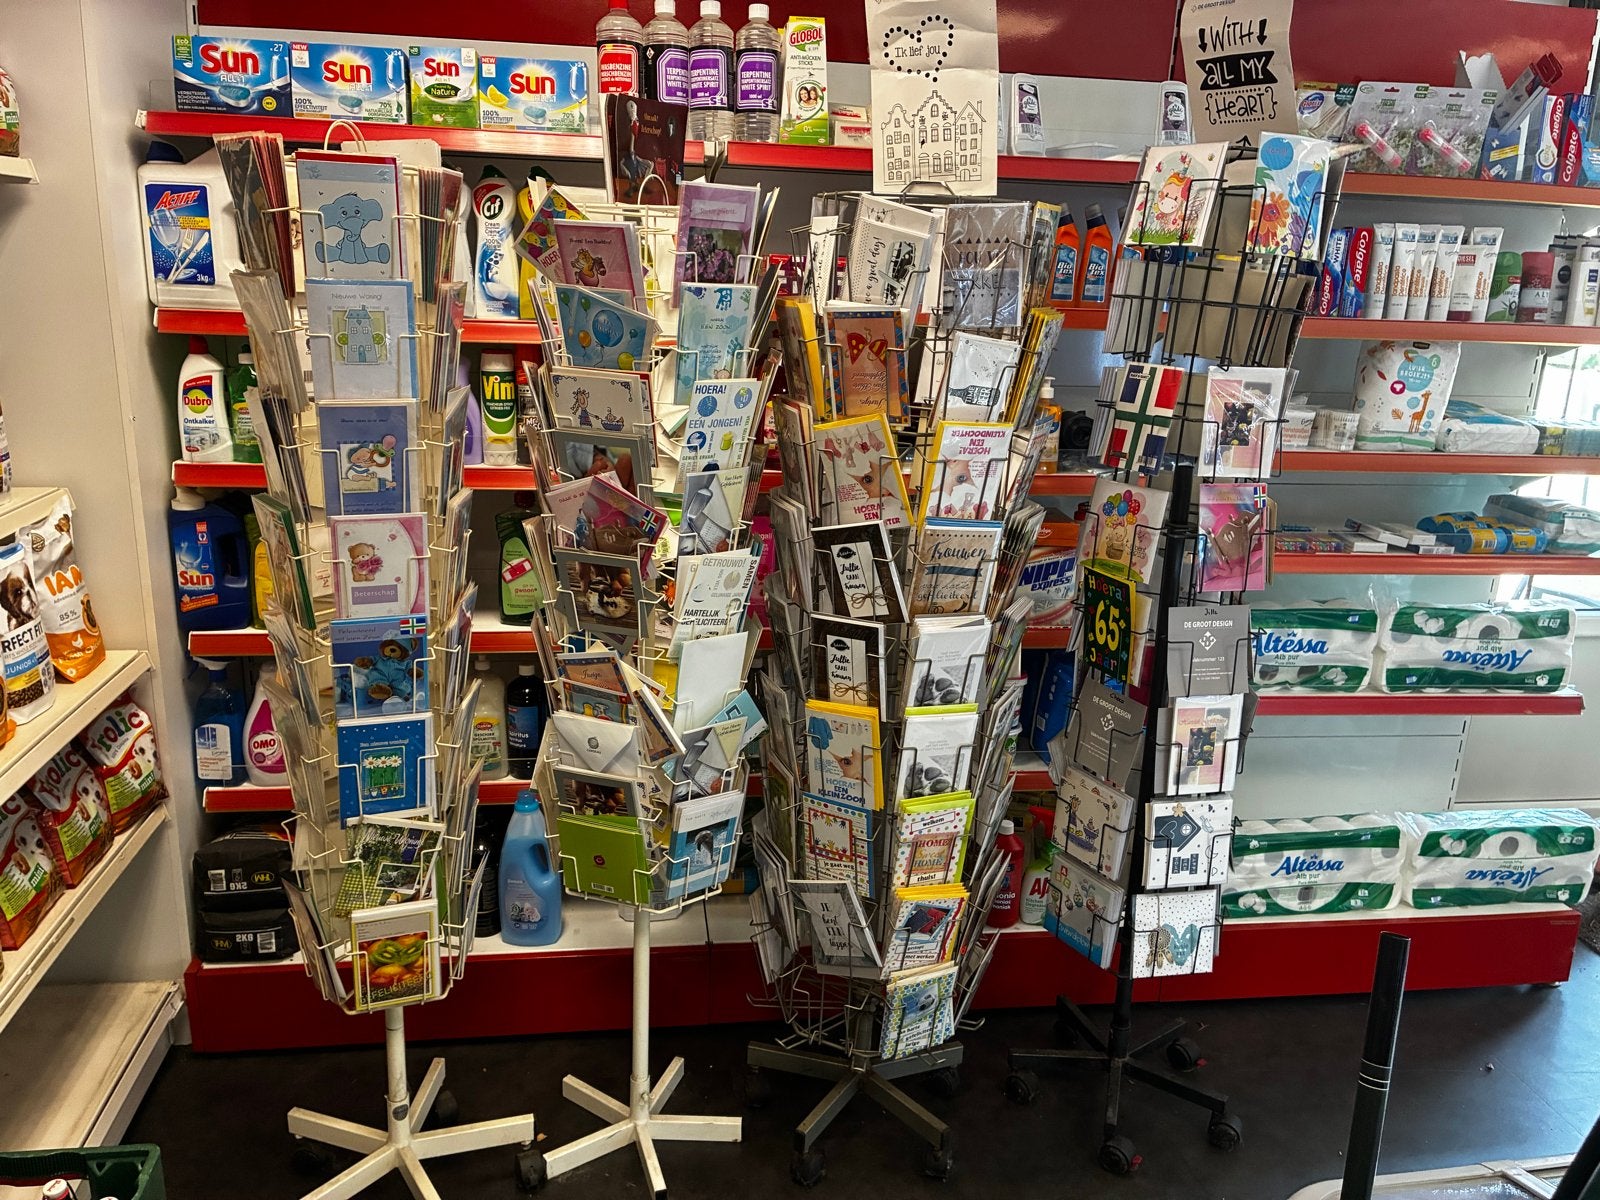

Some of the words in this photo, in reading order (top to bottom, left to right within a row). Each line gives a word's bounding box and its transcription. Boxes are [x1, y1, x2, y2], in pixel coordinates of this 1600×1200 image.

[790, 28, 823, 45] GLOBOL
[200, 43, 261, 76] Sun
[894, 47, 908, 57] Ik
[908, 44, 924, 57] lief
[926, 45, 941, 58] jou
[323, 60, 372, 84] Sun
[424, 57, 460, 77] Sun
[741, 70, 772, 80] TERPENTINE
[1239, 56, 1266, 84] MY
[431, 88, 455, 96] Nature
[510, 73, 557, 95] Sun
[294, 97, 313, 105] 100%
[482, 110, 500, 118] 100%
[1550, 97, 1565, 140] Colgate
[1561, 131, 1579, 183] Colgate
[153, 190, 201, 211] ACTIFF
[483, 196, 501, 217] Cif
[1333, 235, 1344, 262] WHITE
[1351, 230, 1370, 284] Colgate
[1318, 274, 1332, 316] Colgate
[482, 375, 515, 400] Vim
[694, 384, 728, 395] HOERA!
[184, 396, 213, 407] Dubro
[183, 416, 215, 426] Ontkalker
[687, 419, 706, 429] EEN
[707, 416, 744, 428] JONGEN!
[951, 429, 1008, 439] KLEINDOCHTER
[968, 438, 986, 447] EEN
[863, 512, 880, 521] EEN
[179, 569, 215, 587] Sun
[741, 558, 759, 589] SAMEN
[1030, 576, 1073, 592] express
[683, 608, 721, 618] HARTELIJK
[1094, 600, 1121, 652] 65
[1183, 620, 1192, 628] DE
[1192, 619, 1212, 628] GROOT
[1212, 619, 1234, 628] DESIGN
[5, 657, 32, 676] JUNIOR
[1100, 698, 1115, 711] GROOT
[1114, 706, 1133, 720] DESIGN
[252, 737, 278, 750] OMO
[833, 786, 849, 794] EEN
[916, 838, 950, 850] HOME
[912, 858, 944, 870] HOME
[1029, 876, 1051, 899] AJ
